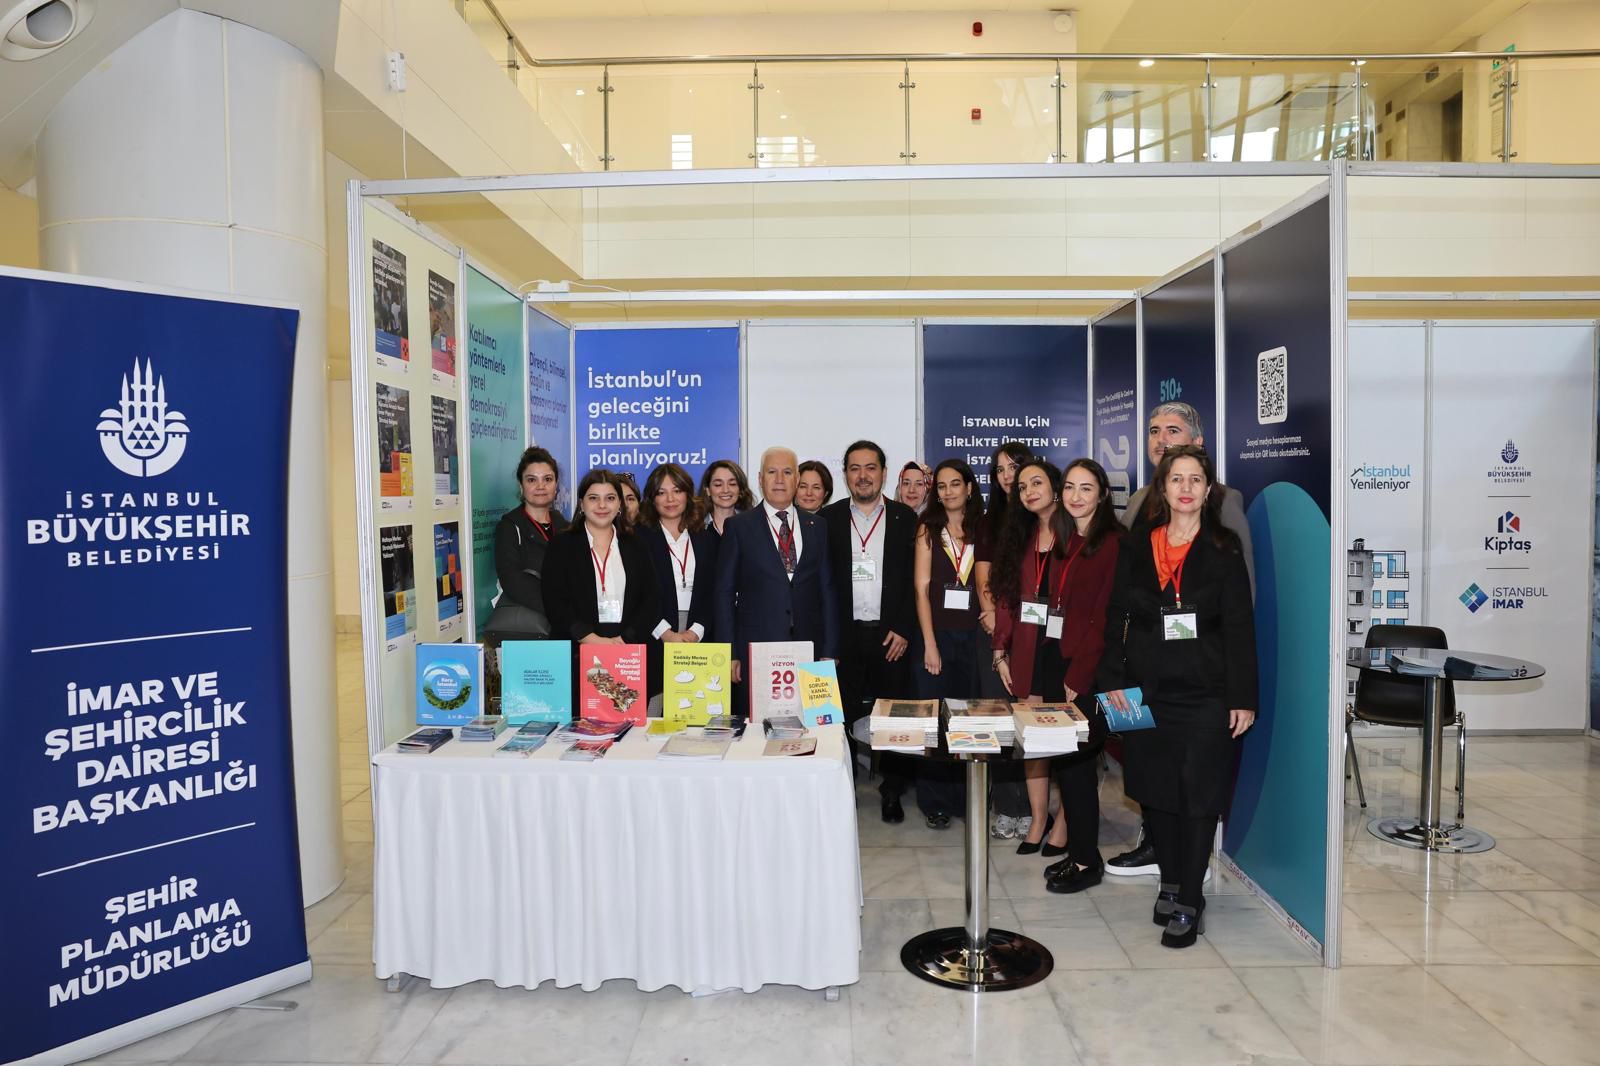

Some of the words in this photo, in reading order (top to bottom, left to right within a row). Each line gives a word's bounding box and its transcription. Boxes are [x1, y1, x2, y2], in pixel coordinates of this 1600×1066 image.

[469, 348, 506, 376] yöntemlerle
[469, 373, 486, 392] yerel
[588, 367, 702, 388] İstanbul'un
[588, 396, 689, 418] geleceğini
[588, 423, 660, 440] birlikte
[963, 416, 1022, 427] İSTANBUL
[1025, 416, 1050, 428] İÇİN
[944, 436, 998, 447] BİRLİKTE
[1053, 438, 1068, 447] VE
[589, 448, 707, 469] planlıyoruz!
[1350, 477, 1411, 492] Yenileniyor
[66, 491, 218, 508] İSTANBUL
[27, 510, 250, 544] BÜYÜKŞEHİR
[67, 543, 220, 567] BELEDİYESİ
[1484, 536, 1532, 554] Kiptaş
[772, 670, 794, 684] 20
[67, 679, 163, 716] İMAR
[171, 672, 218, 698] VE
[772, 686, 794, 700] 50
[44, 697, 247, 761] ŞEHİRCİLİK
[77, 732, 220, 788] DAİRESİ
[33, 760, 257, 834] BAŞKANLIĞI
[105, 876, 198, 924] ŞEHİR
[61, 898, 241, 968] PLANLAMA
[49, 920, 252, 1008] MÜDÜRLÜĞÜ
